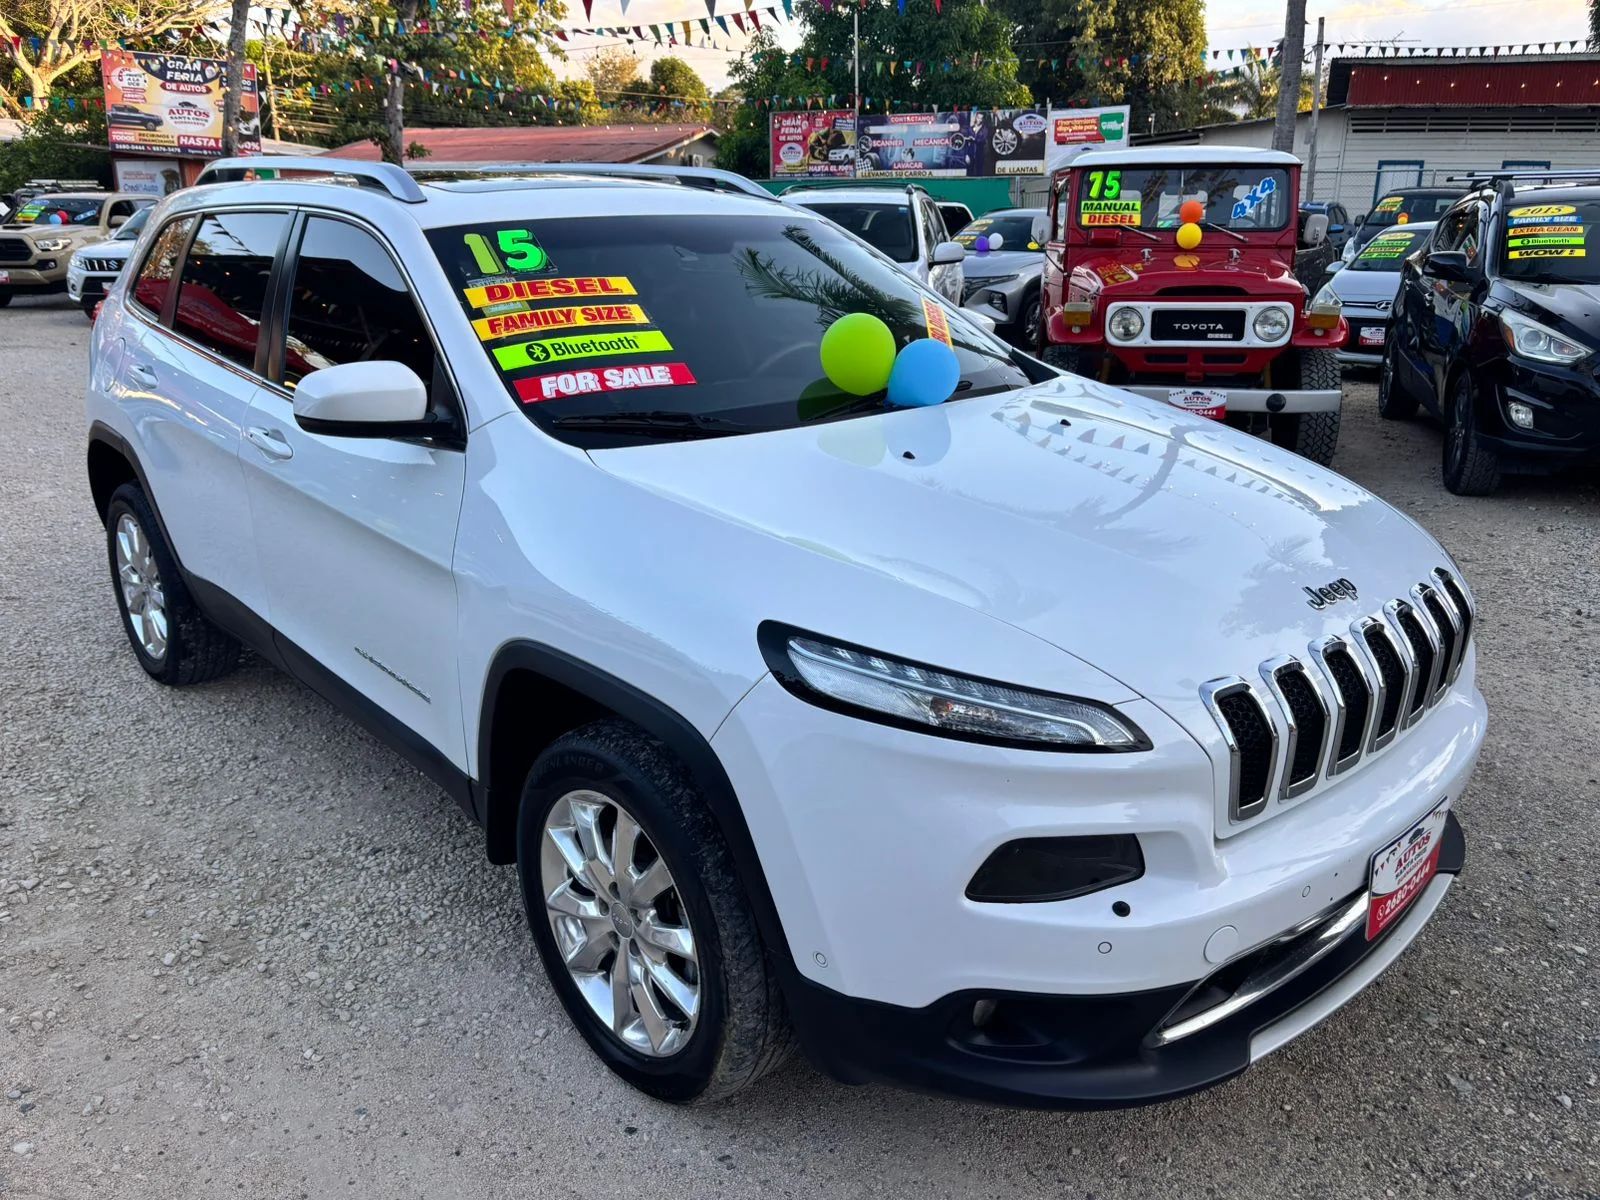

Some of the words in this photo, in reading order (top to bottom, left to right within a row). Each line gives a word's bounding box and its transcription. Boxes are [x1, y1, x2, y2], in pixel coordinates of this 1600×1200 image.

[166, 60, 201, 71] GRAN
[166, 71, 204, 82] FERIA
[165, 83, 177, 91] DE
[179, 84, 207, 93] AUTOS
[168, 108, 210, 118] AUTOS
[781, 118, 802, 127] GRAN
[780, 126, 802, 134] FERIA
[112, 134, 135, 142] TODOS
[179, 136, 216, 148] HASTA
[872, 139, 903, 147] SCANNER
[1089, 170, 1121, 200] 75
[1082, 202, 1139, 212] MANUAL
[1518, 206, 1564, 216] 2015
[1088, 214, 1135, 224] DIESEL
[1513, 216, 1552, 225] FAMILY
[1512, 226, 1546, 234] EXTRA
[463, 229, 547, 275] 15
[1518, 249, 1565, 257] WOW
[484, 277, 624, 302] DIESEL
[487, 308, 578, 336] FAMILY
[580, 305, 635, 323] SIZE
[1173, 322, 1224, 330] TOYOTA
[550, 336, 639, 357] Bluetooth
[540, 371, 601, 399] FOR
[604, 366, 673, 389] SALE
[1301, 577, 1359, 611] Jeep
[1394, 831, 1432, 874] AUTOS
[1385, 860, 1431, 915] 2680-0444
